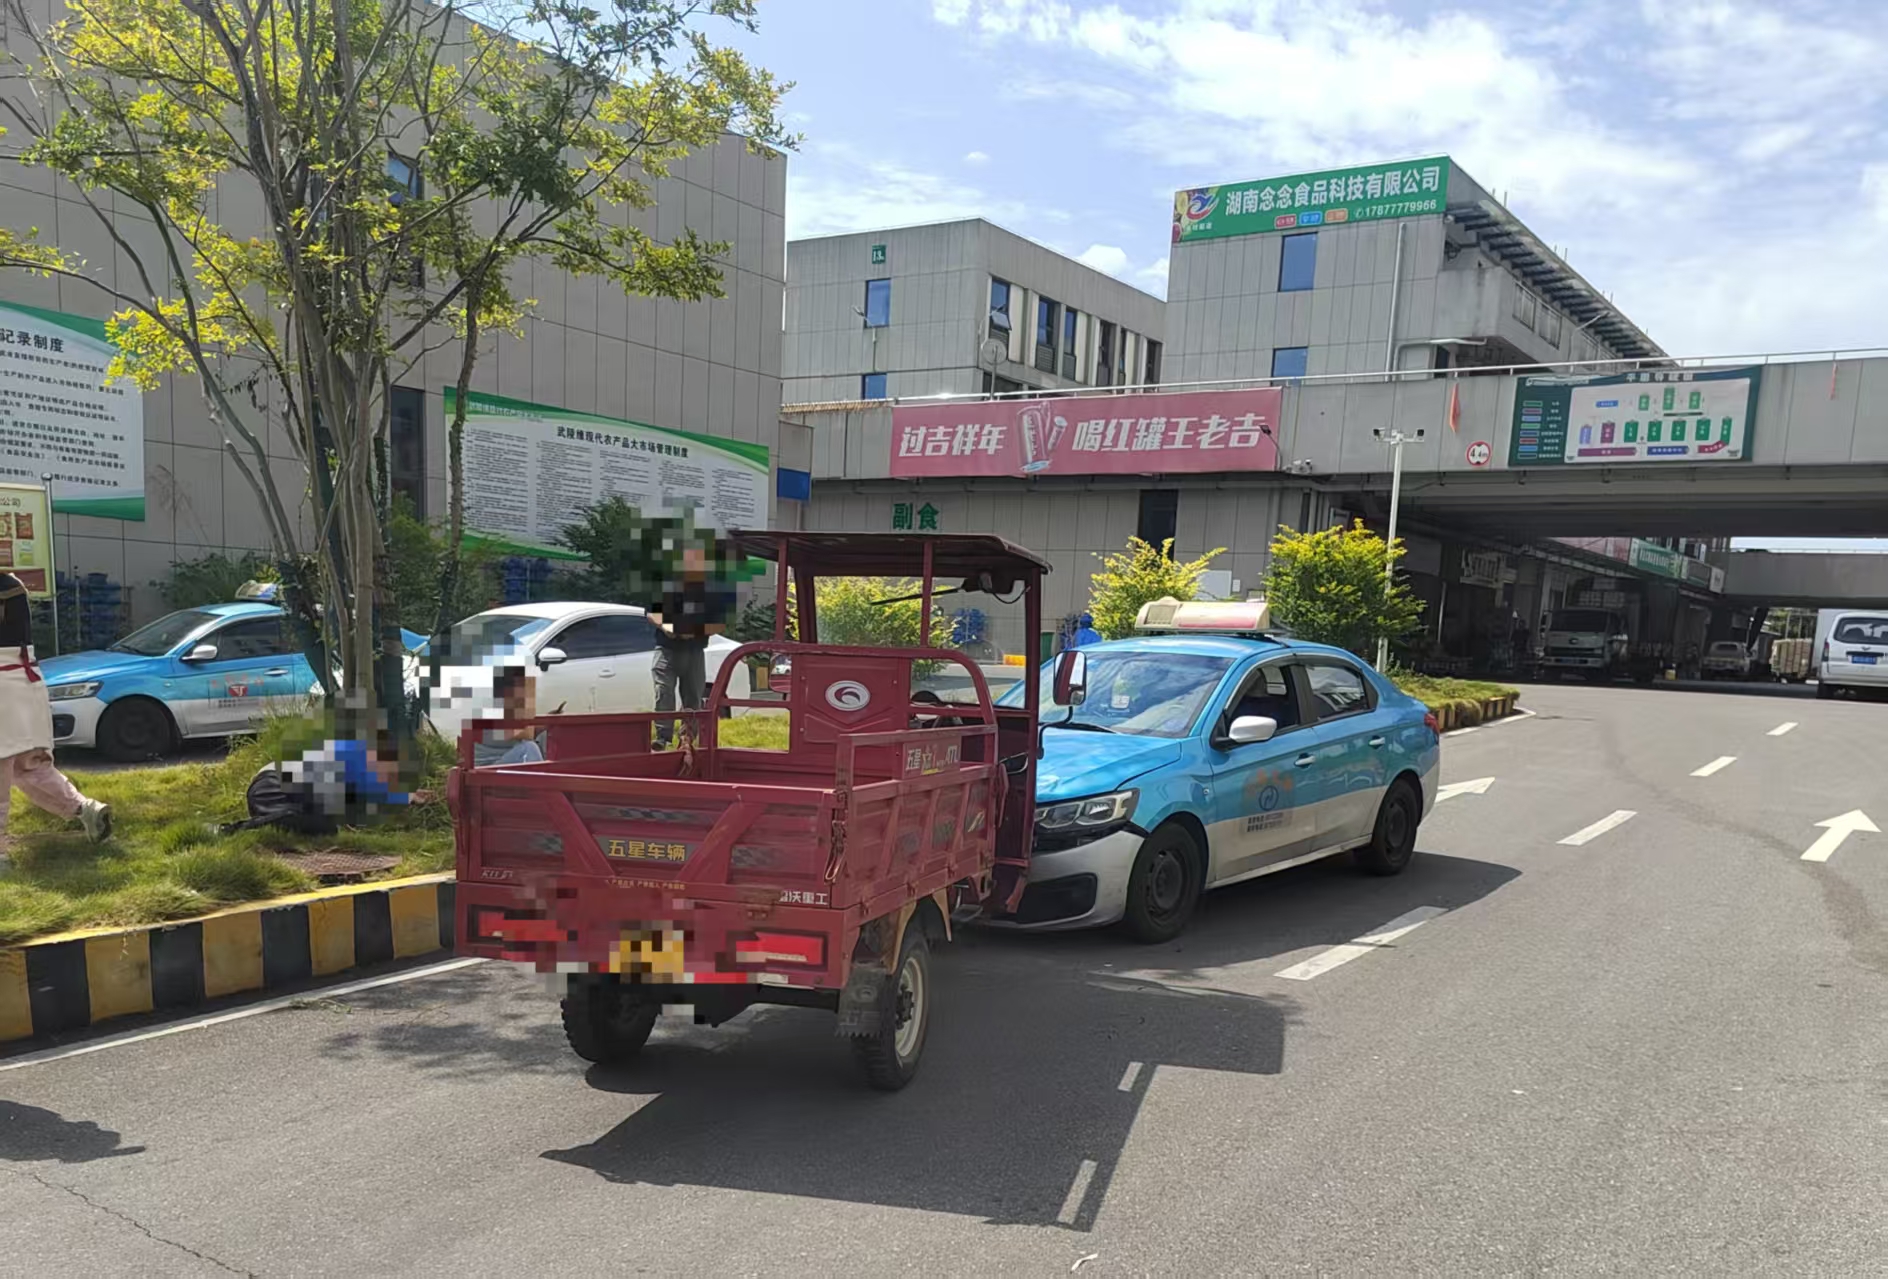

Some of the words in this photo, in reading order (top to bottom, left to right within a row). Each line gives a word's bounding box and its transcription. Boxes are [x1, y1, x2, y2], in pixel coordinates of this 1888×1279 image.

[1226, 166, 1440, 216] 湖南念念食品科技有限公司
[1366, 199, 1437, 217] 17877779966
[0, 328, 65, 353] 记录制度
[898, 424, 1008, 457] 过吉祥年
[1072, 413, 1266, 453] 喝红罐王老吉
[892, 503, 940, 531] 副食
[608, 838, 686, 862] 五星车辆
